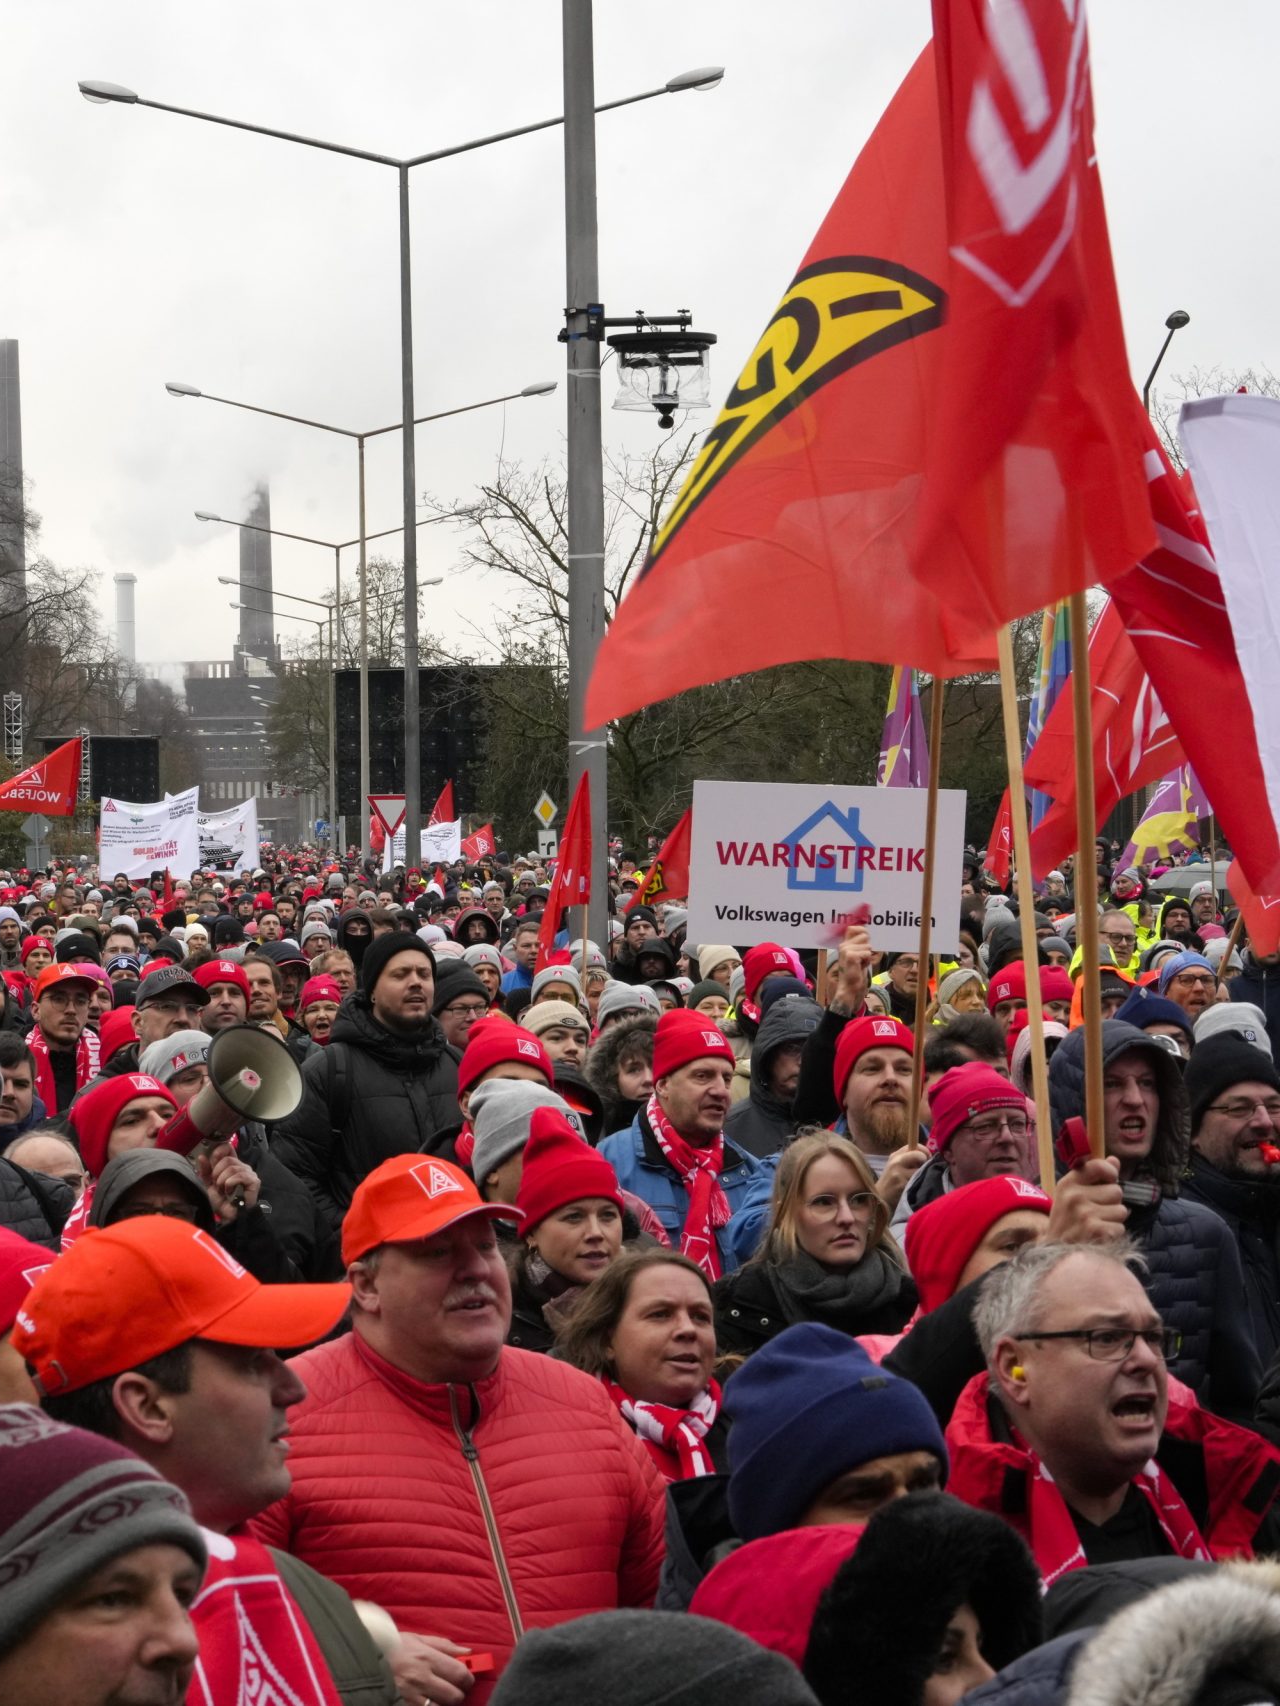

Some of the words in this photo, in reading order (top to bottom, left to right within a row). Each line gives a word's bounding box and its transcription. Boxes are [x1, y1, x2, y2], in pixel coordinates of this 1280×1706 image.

[716, 841, 926, 873] WARNSTREIK
[715, 905, 825, 927] Volkswagen
[831, 909, 936, 928] Imobilien
